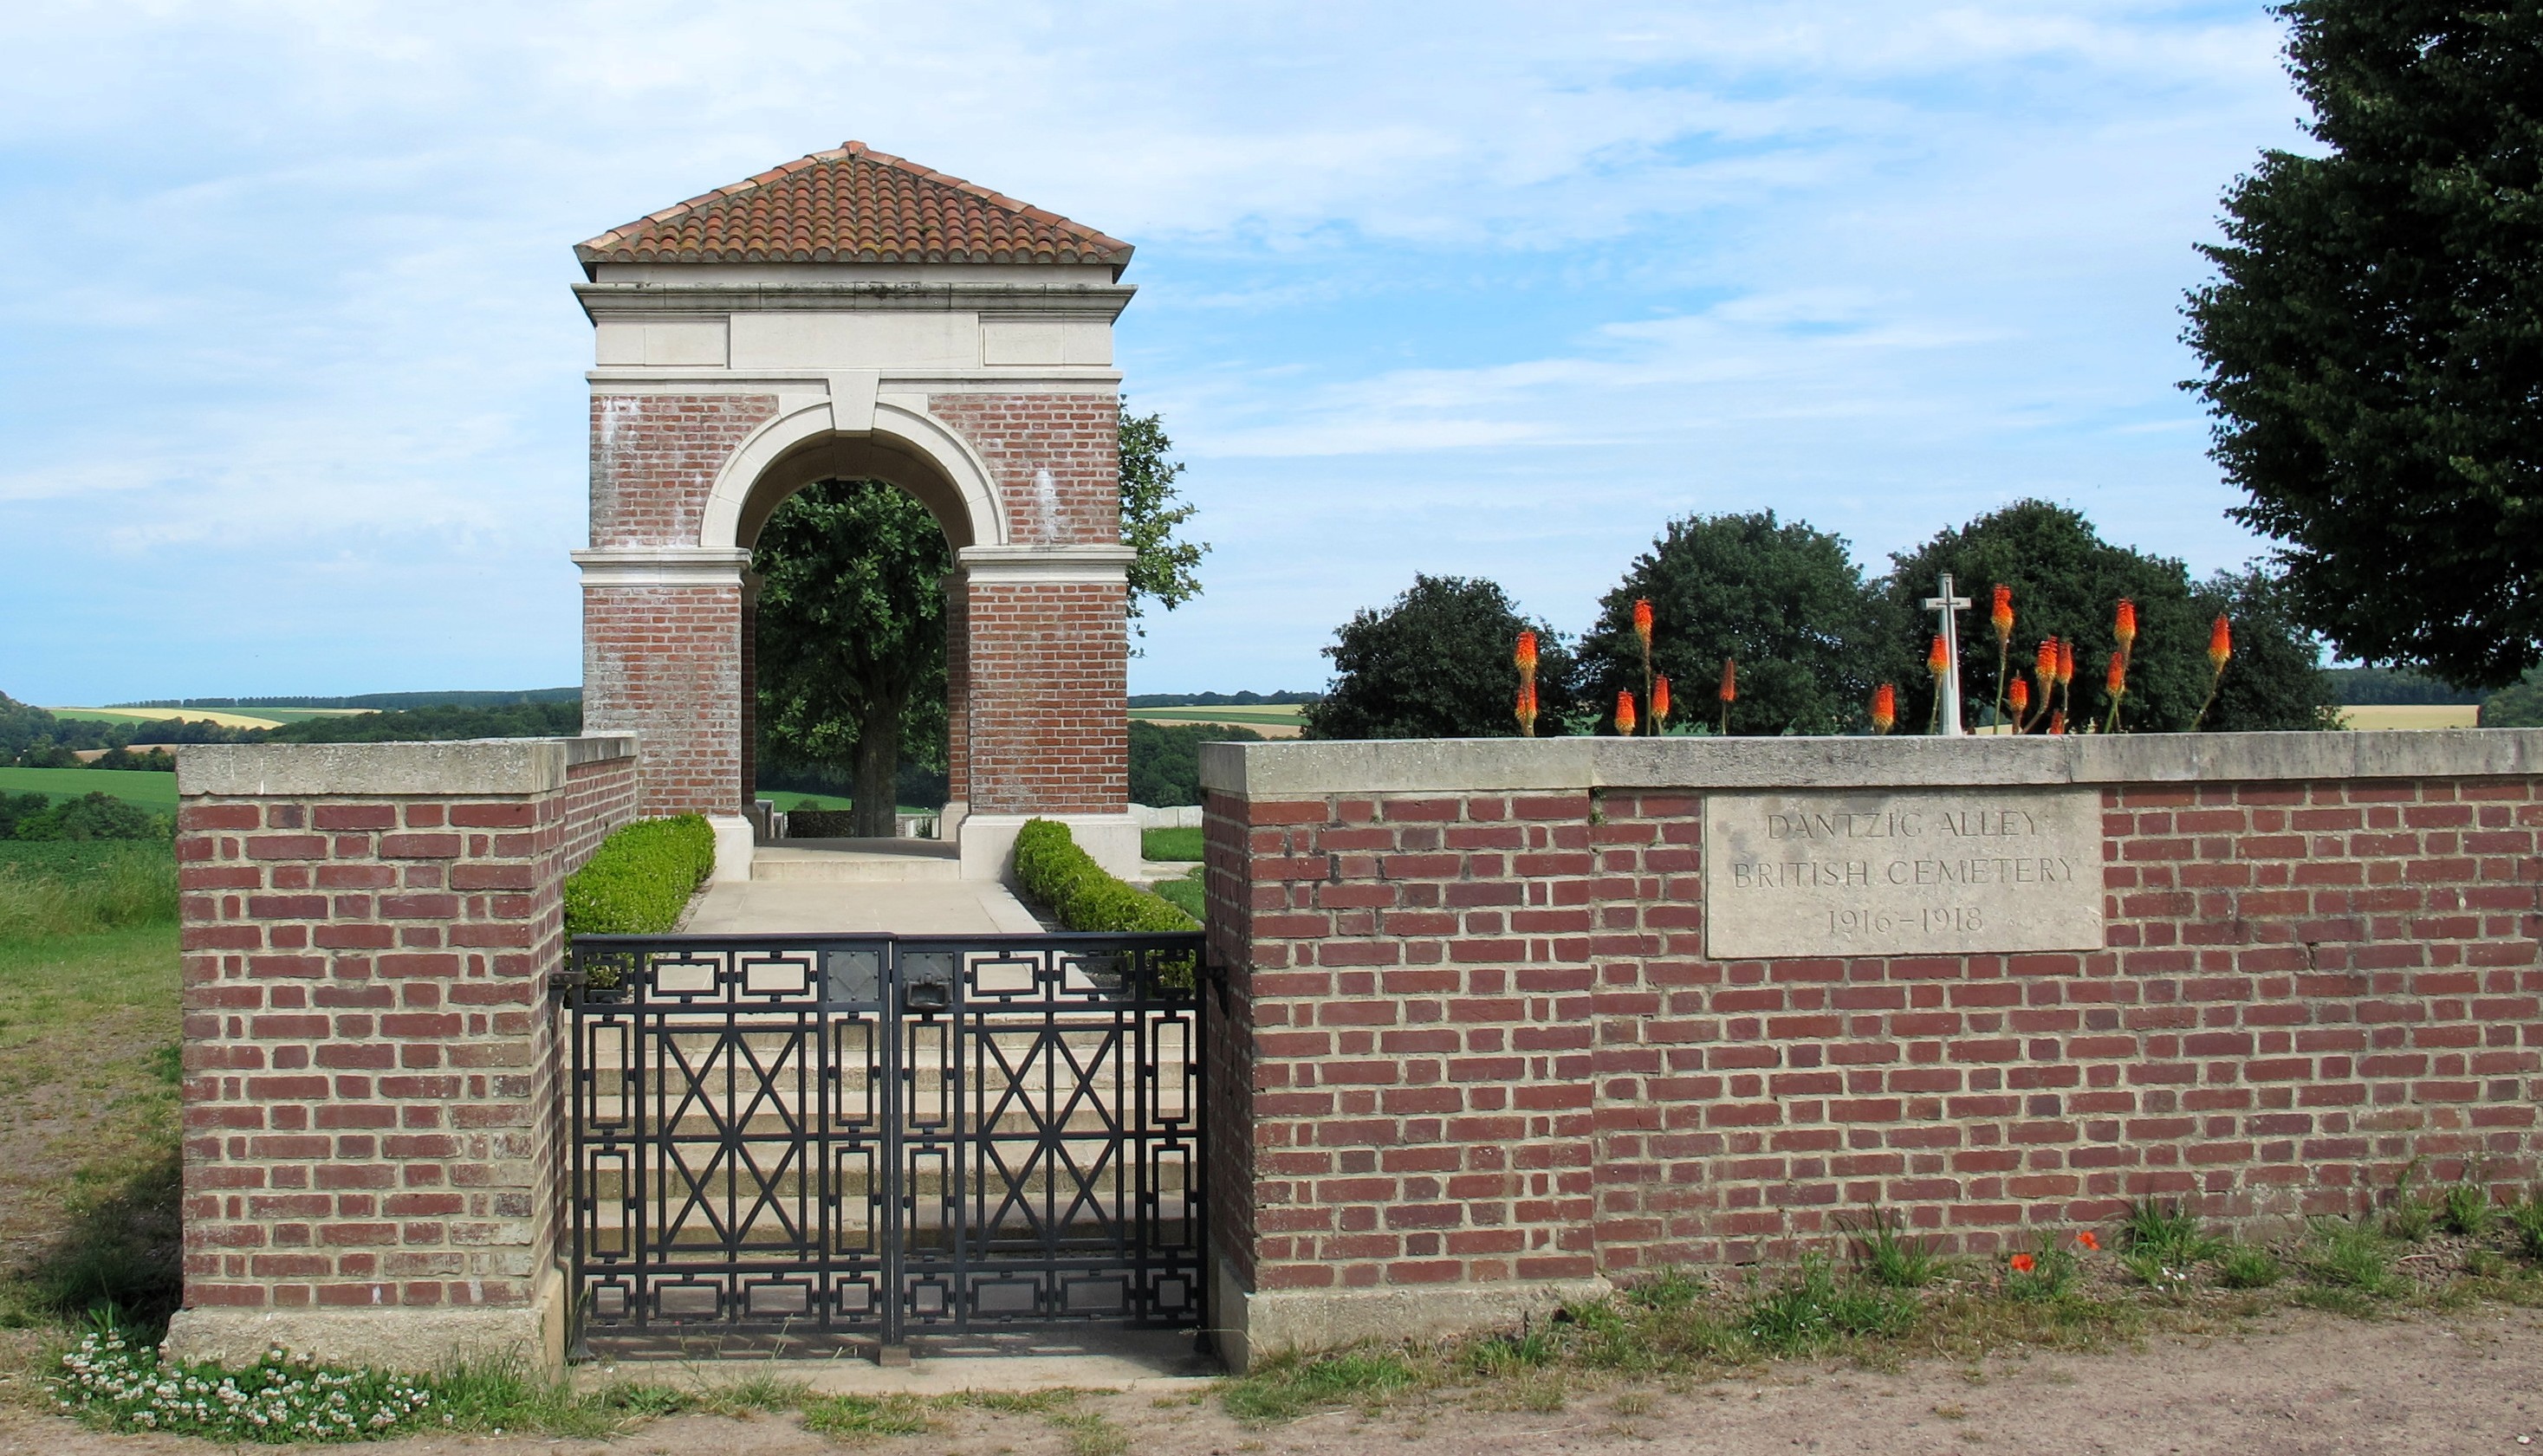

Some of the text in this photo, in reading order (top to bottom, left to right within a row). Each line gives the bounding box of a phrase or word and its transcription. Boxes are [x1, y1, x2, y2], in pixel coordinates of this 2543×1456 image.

[1767, 810, 2039, 840] DANTZIG ALLEY
[1734, 858, 2077, 889] BRITISH CEMETERY
[1828, 907, 1984, 935] 1916-1918
